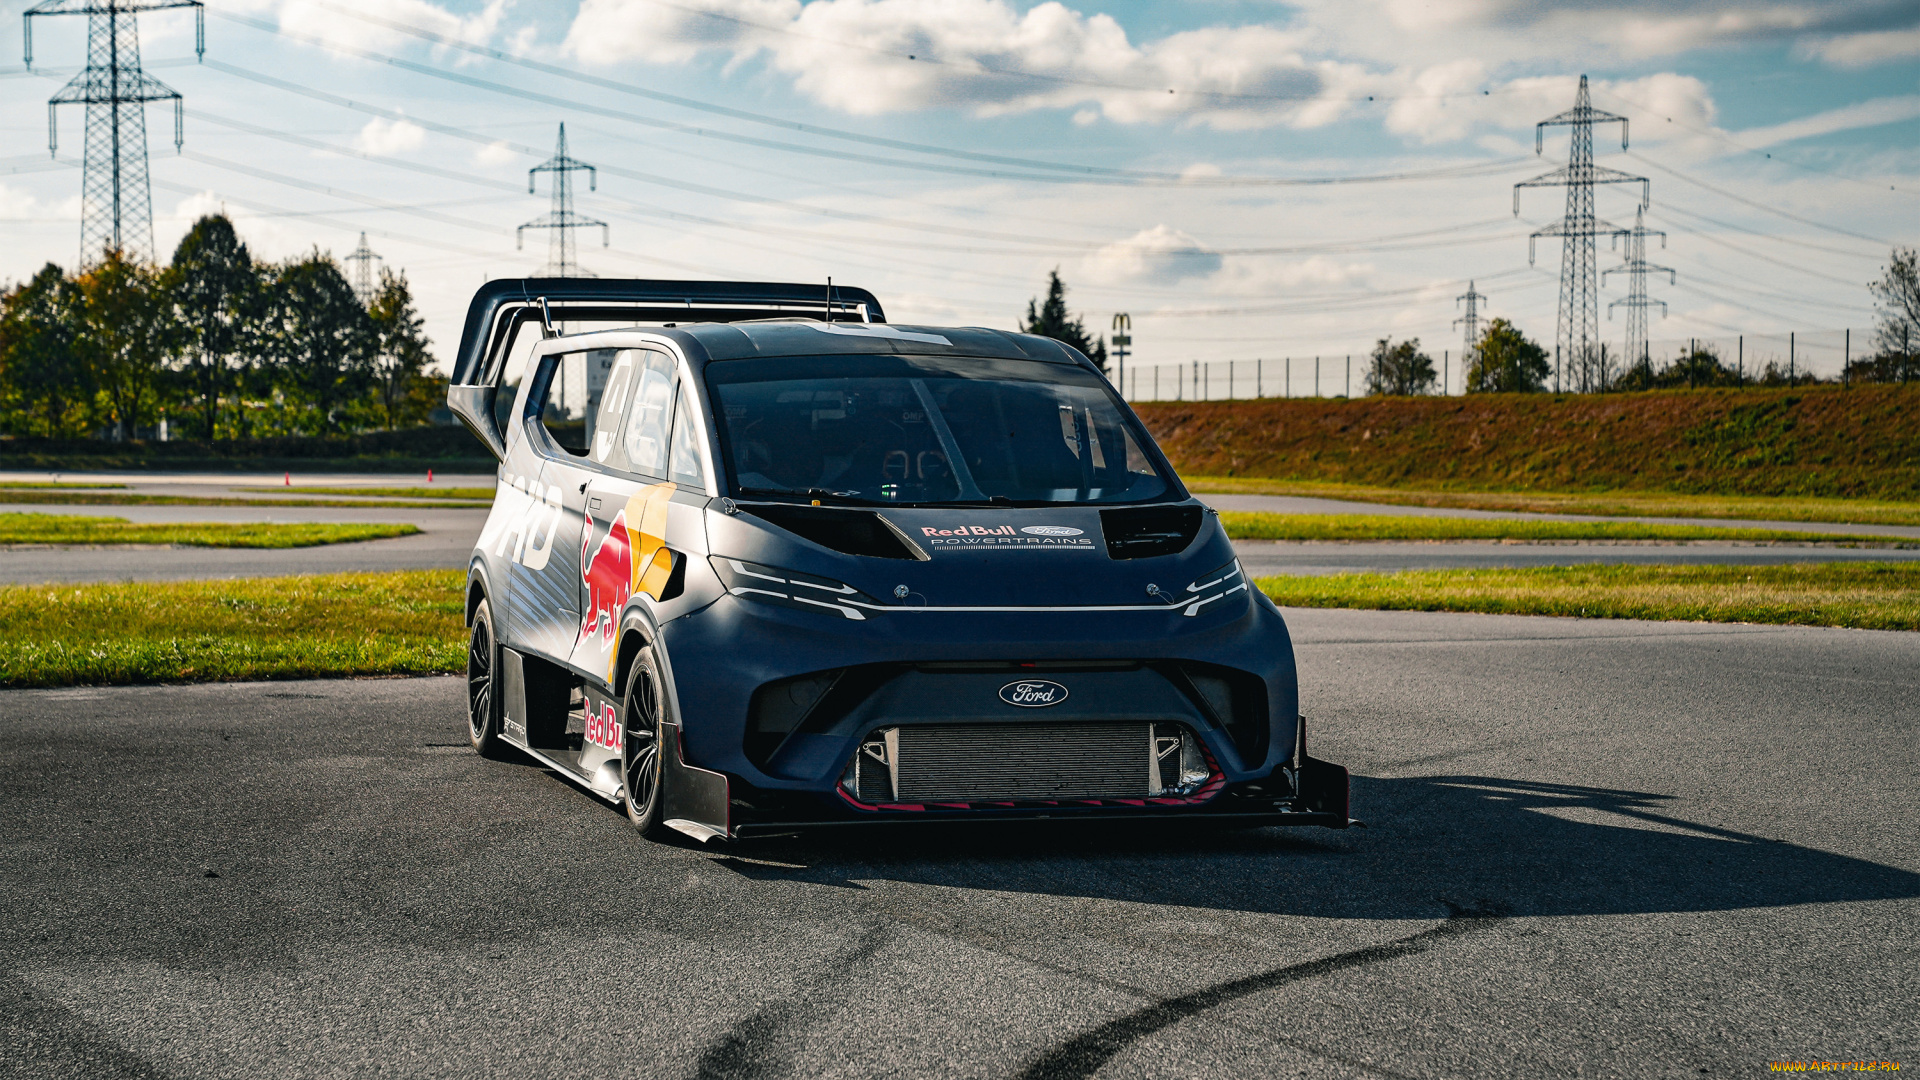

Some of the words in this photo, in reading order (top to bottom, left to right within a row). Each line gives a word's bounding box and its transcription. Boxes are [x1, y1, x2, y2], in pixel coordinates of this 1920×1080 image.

[920, 526, 970, 537] Red
[970, 525, 1017, 536] Bull
[1033, 526, 1072, 536] Ford
[931, 537, 1092, 545] POWERTRAINS
[1012, 683, 1055, 702] Ford
[584, 695, 605, 745] Red
[604, 704, 622, 754] Bu
